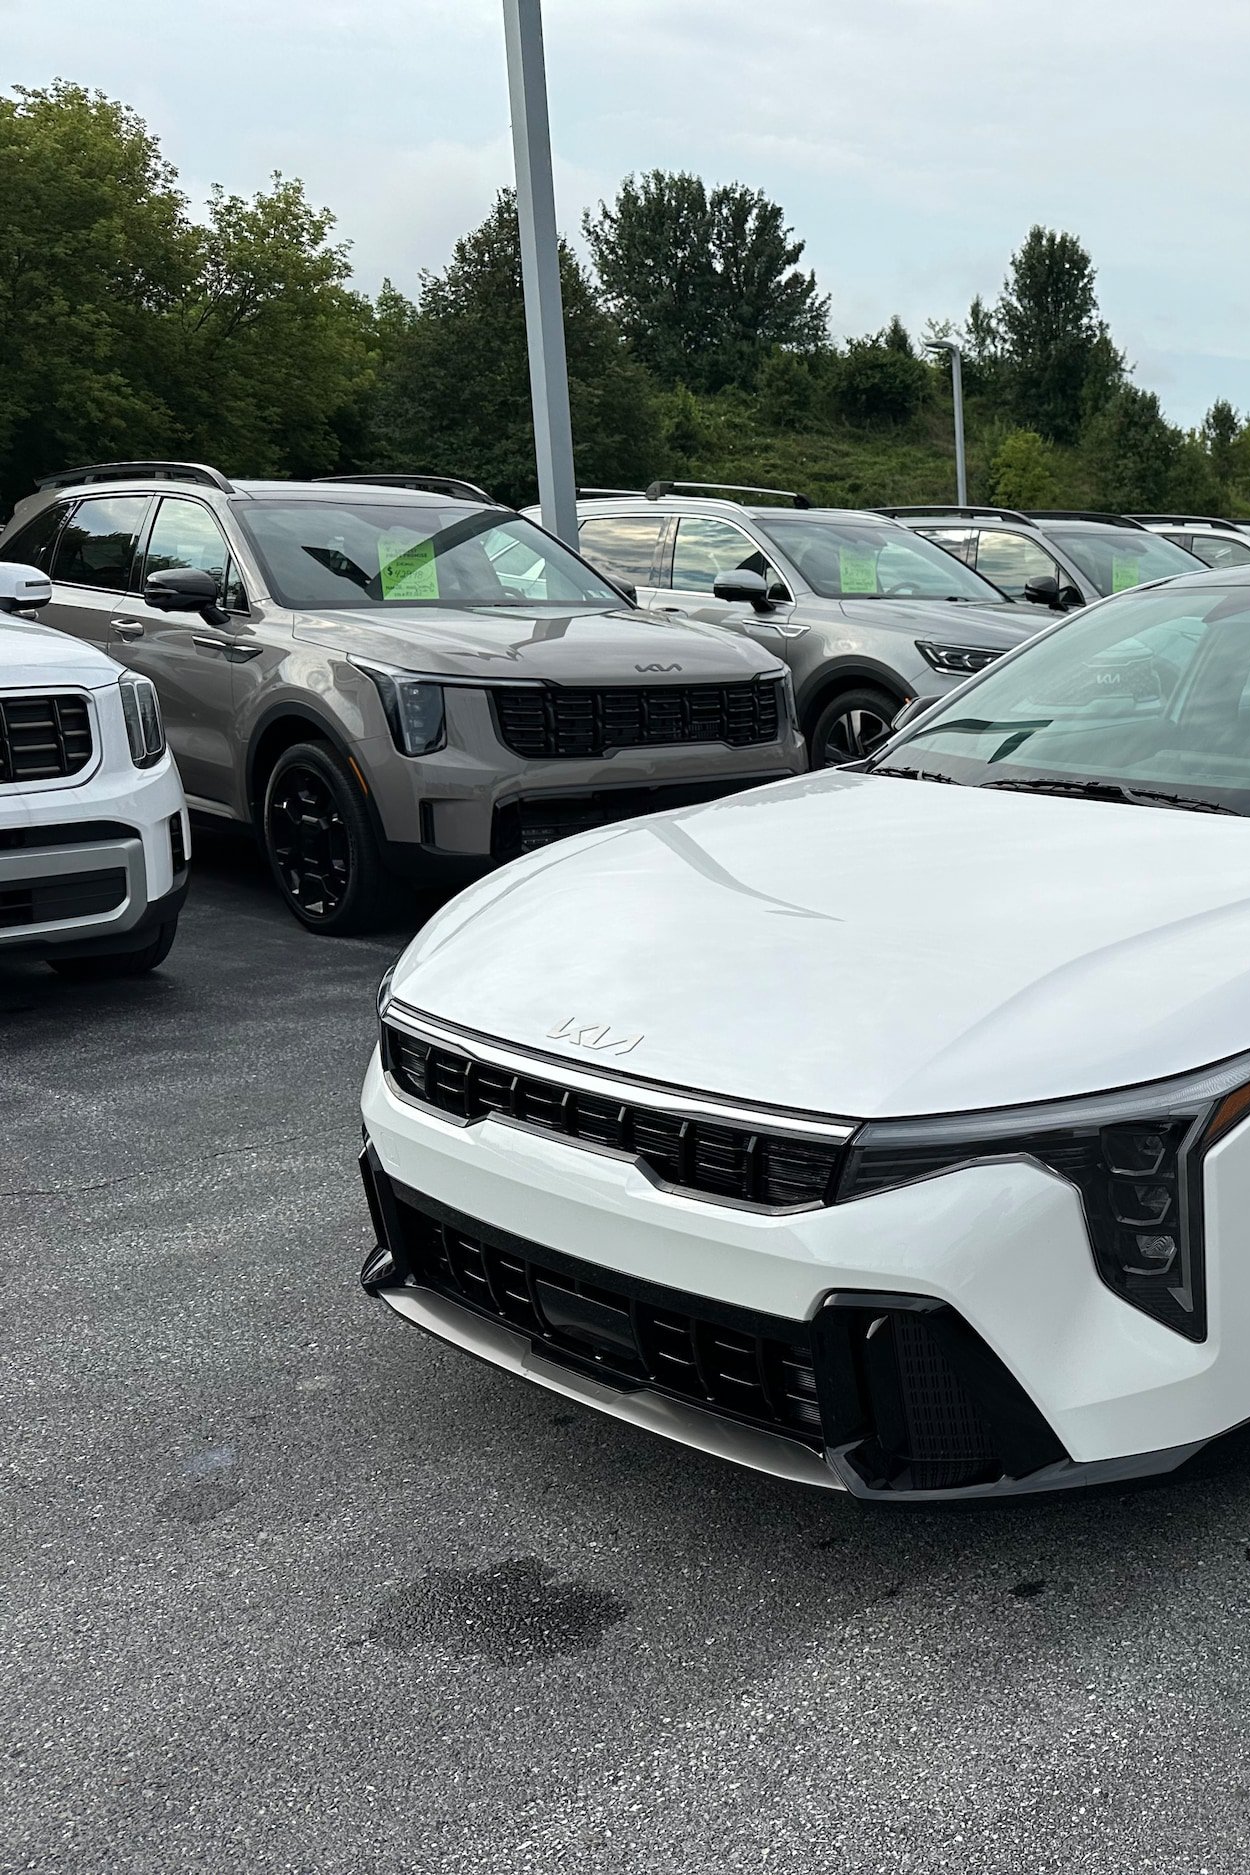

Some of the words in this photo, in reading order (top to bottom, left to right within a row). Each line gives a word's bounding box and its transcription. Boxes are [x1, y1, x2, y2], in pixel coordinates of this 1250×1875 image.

[634, 663, 683, 673] KIA
[1096, 674, 1120, 684] KIA
[545, 1016, 645, 1056] KIA
